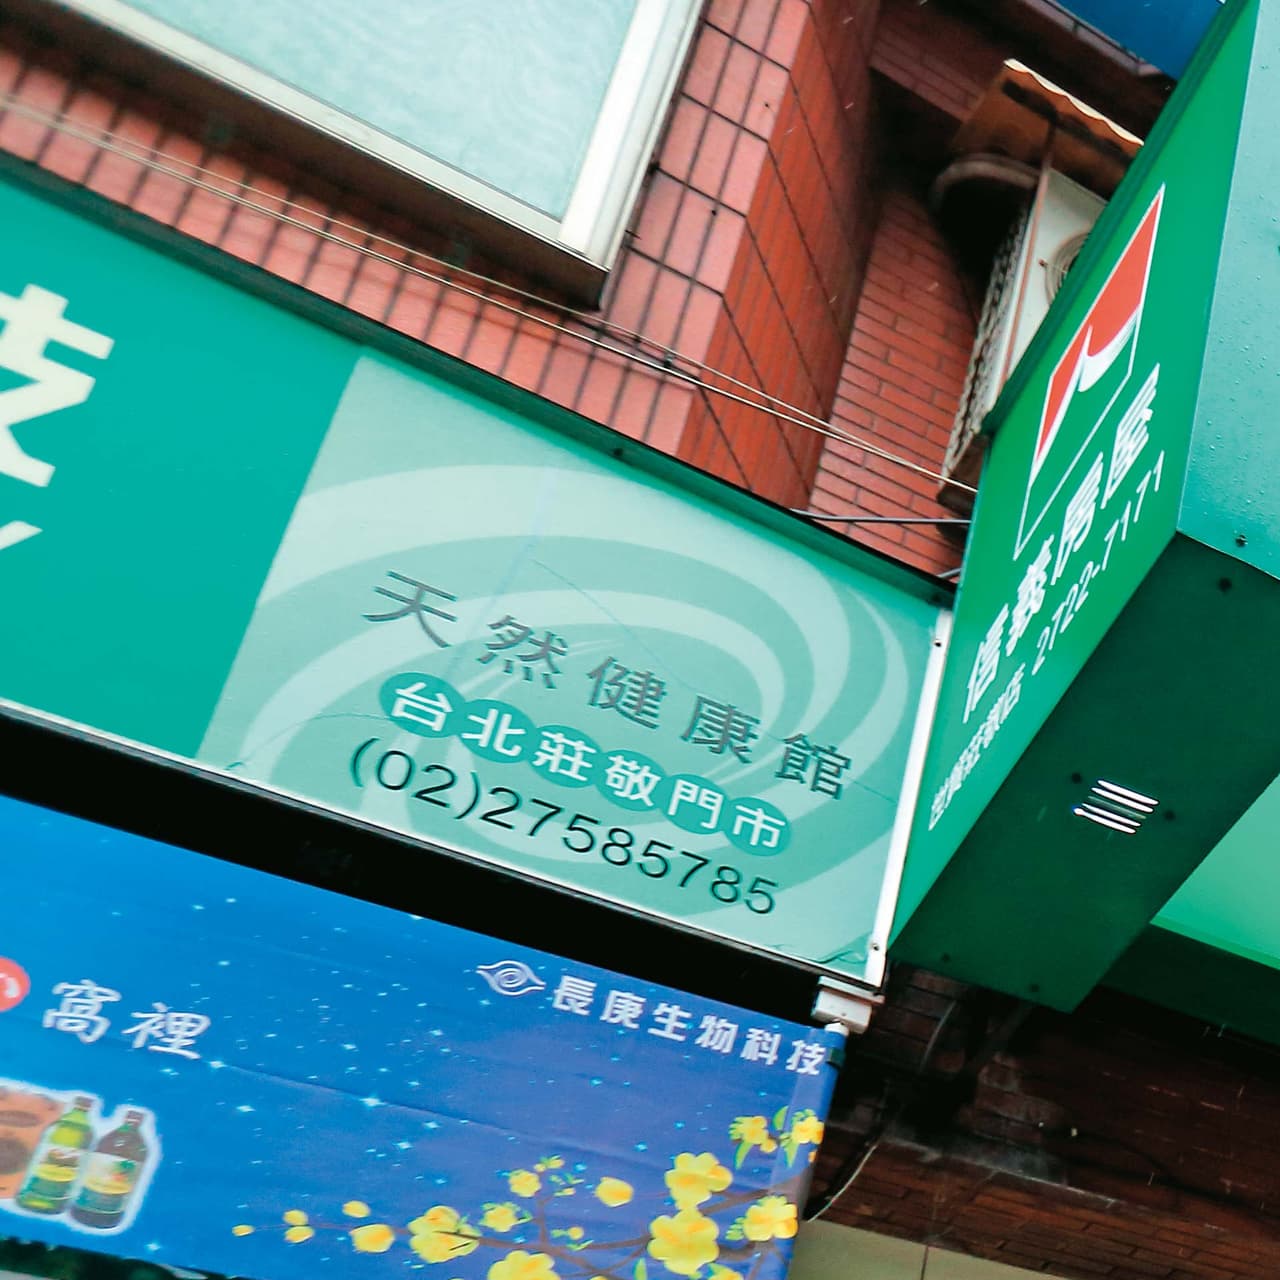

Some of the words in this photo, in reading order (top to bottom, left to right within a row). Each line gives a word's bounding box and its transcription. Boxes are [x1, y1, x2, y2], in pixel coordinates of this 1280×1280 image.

[963, 362, 1160, 723] 信義房屋
[1031, 450, 1164, 675] 2722-7171
[362, 569, 852, 801] 天然健康館
[391, 682, 788, 850] 台北莊敬門市
[350, 737, 778, 914] (02)27585785
[552, 974, 828, 1077] 長庚生物科技
